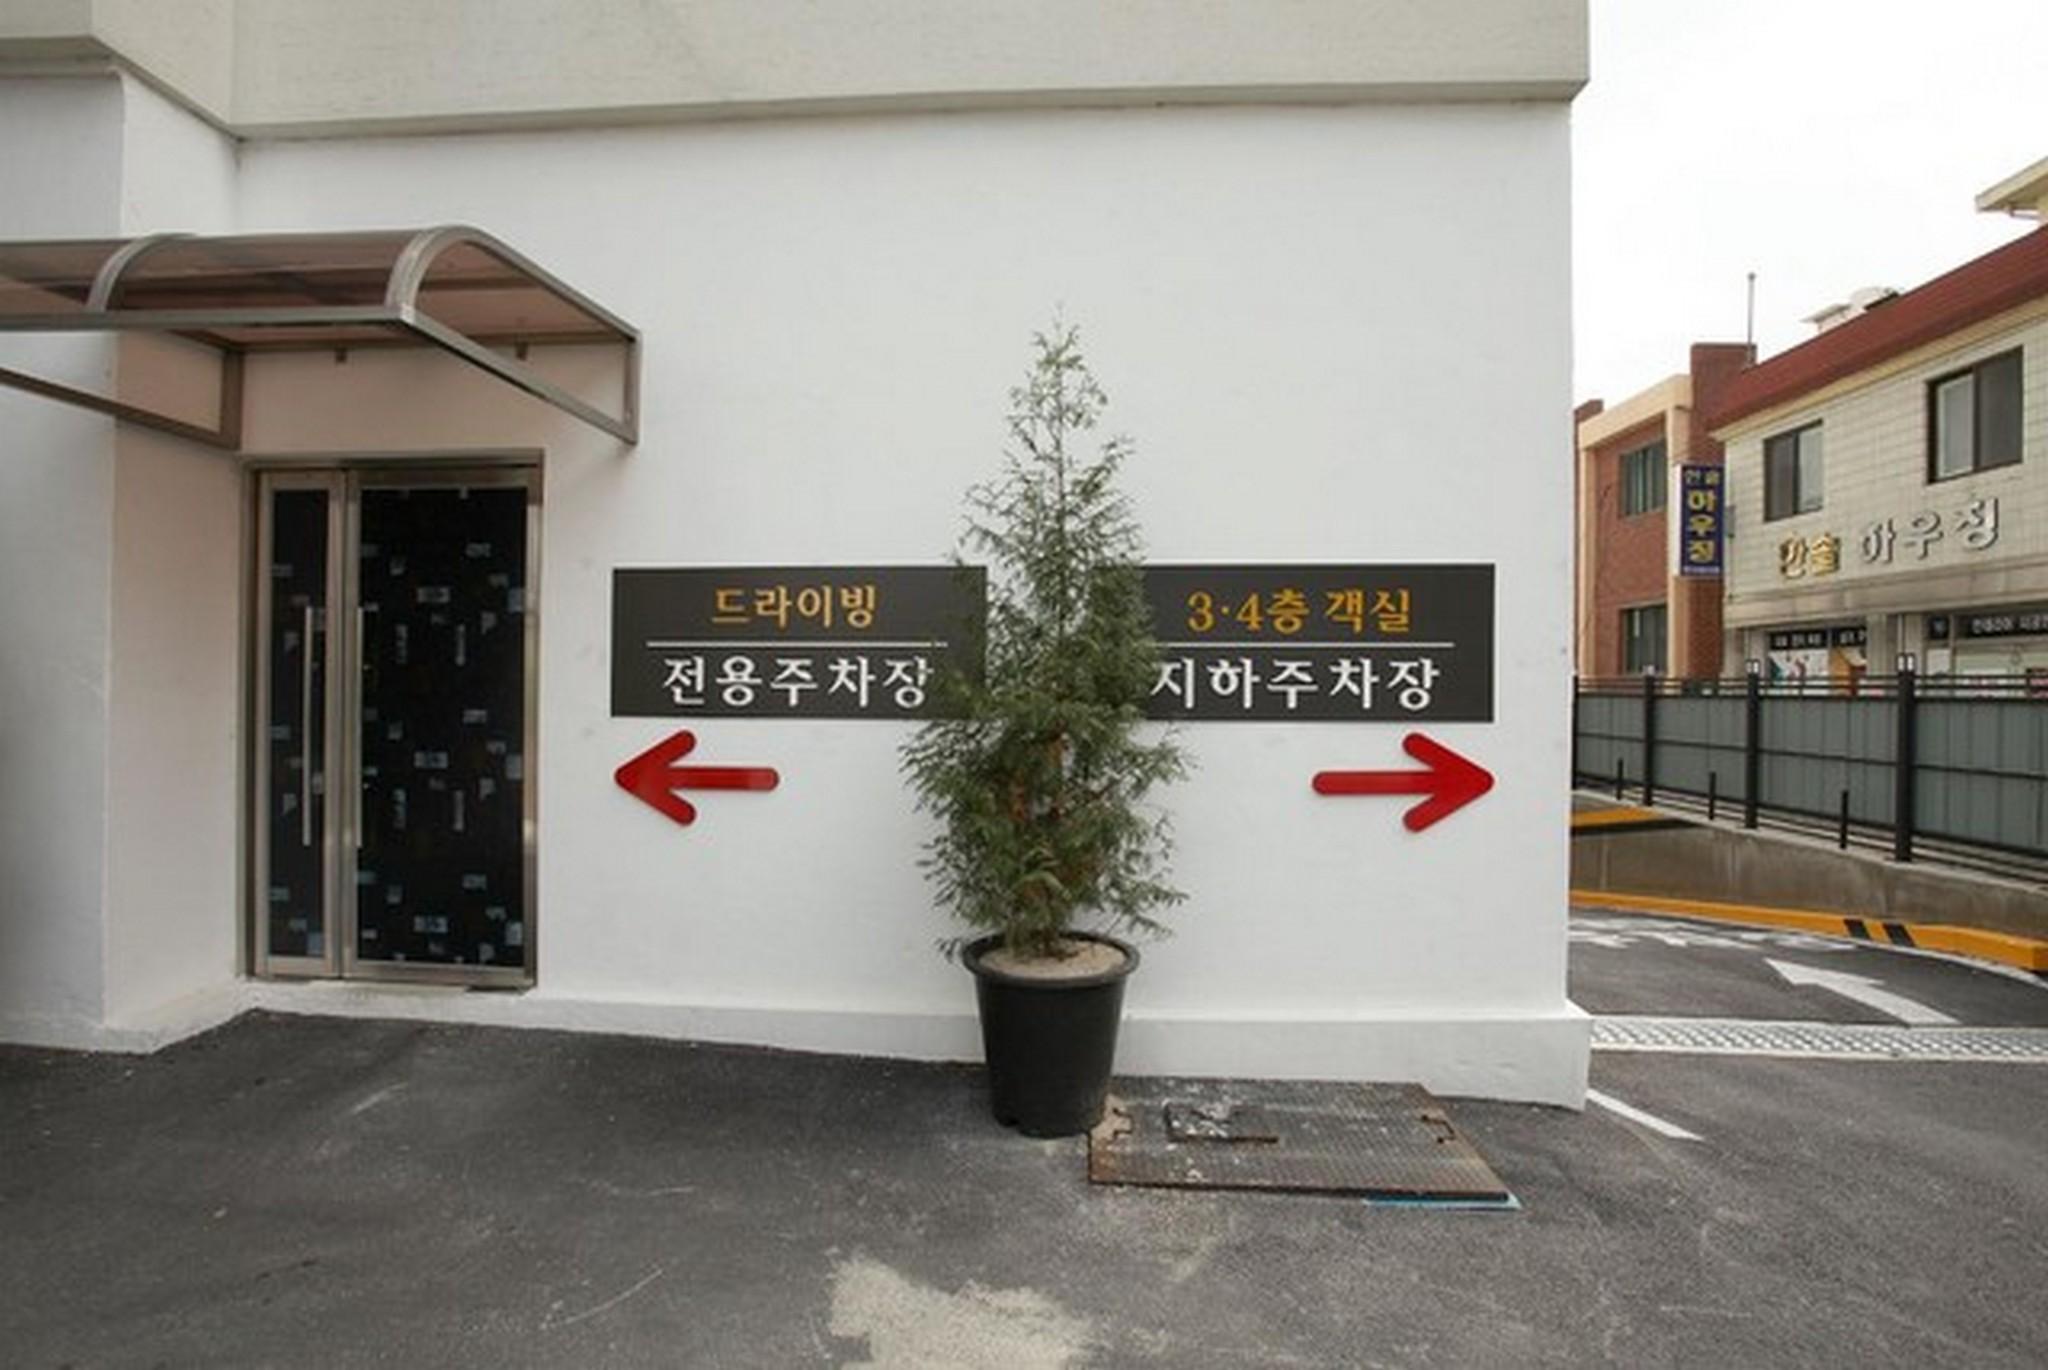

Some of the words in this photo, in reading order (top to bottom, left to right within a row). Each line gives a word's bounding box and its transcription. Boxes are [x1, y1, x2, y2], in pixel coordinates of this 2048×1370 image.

[712, 585, 877, 628] 드라이빙
[1188, 588, 1310, 634] 3·4층
[1325, 588, 1413, 634] 객실
[663, 655, 935, 708] 전용주차장
[1151, 657, 1441, 710] 지하주차장
